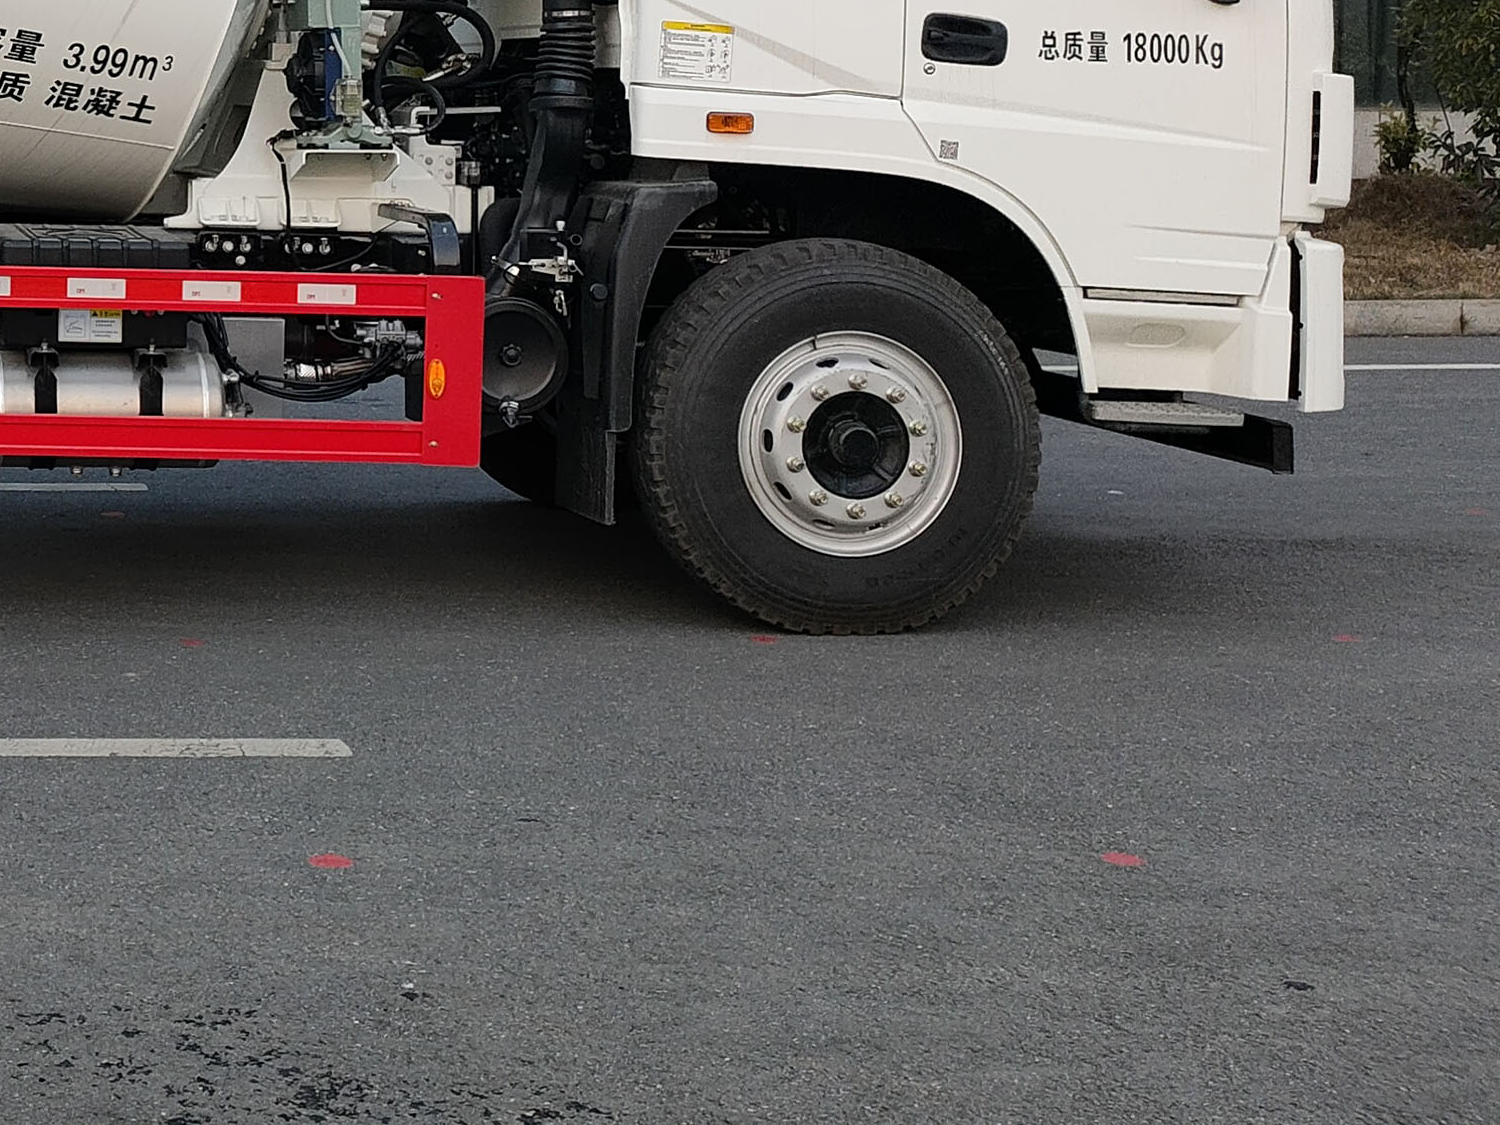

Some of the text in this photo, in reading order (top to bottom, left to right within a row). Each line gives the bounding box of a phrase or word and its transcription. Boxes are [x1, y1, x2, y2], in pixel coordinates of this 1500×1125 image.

[1038, 31, 1225, 70] 总质量 18000Kg
[44, 79, 156, 124] 混凝土
